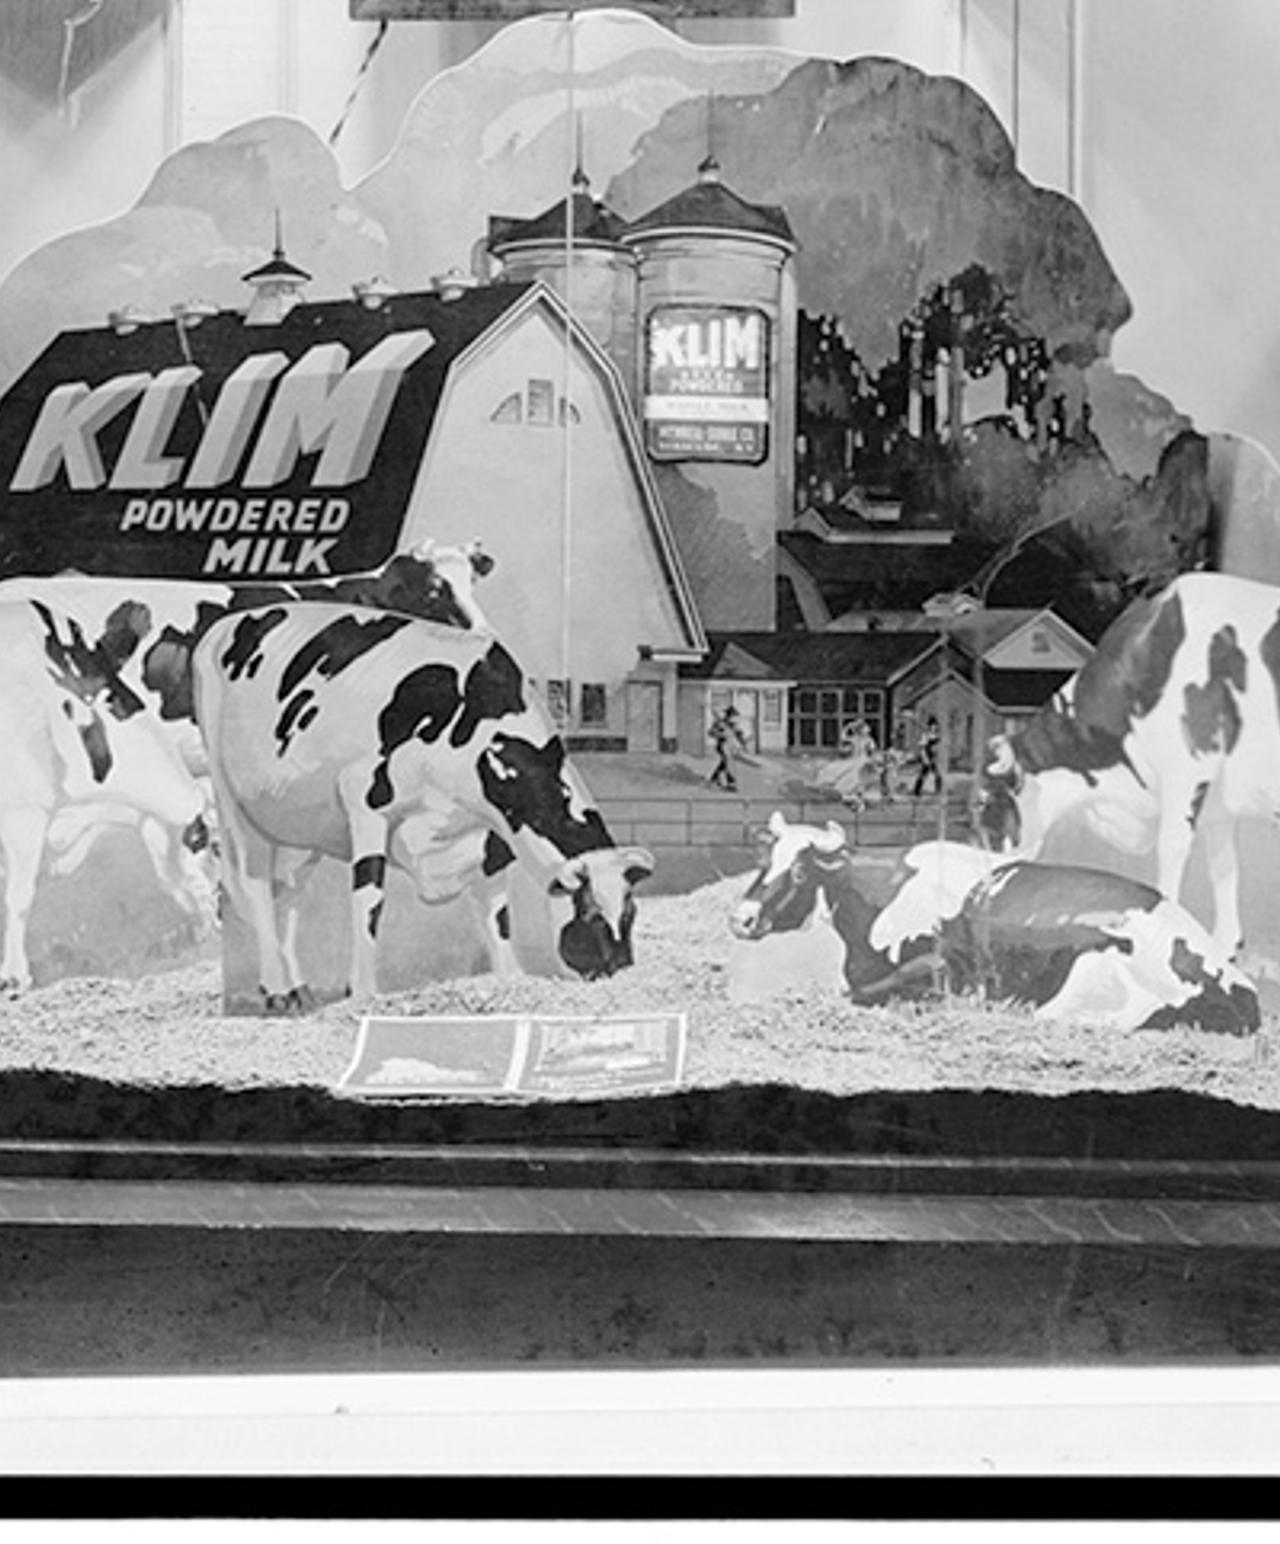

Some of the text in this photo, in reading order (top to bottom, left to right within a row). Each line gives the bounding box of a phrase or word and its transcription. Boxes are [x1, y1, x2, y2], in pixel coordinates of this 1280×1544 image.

[650, 314, 761, 372] KLIM
[9, 327, 438, 494] KLIM
[120, 496, 351, 535] POWDERED
[201, 537, 340, 576] MILK
